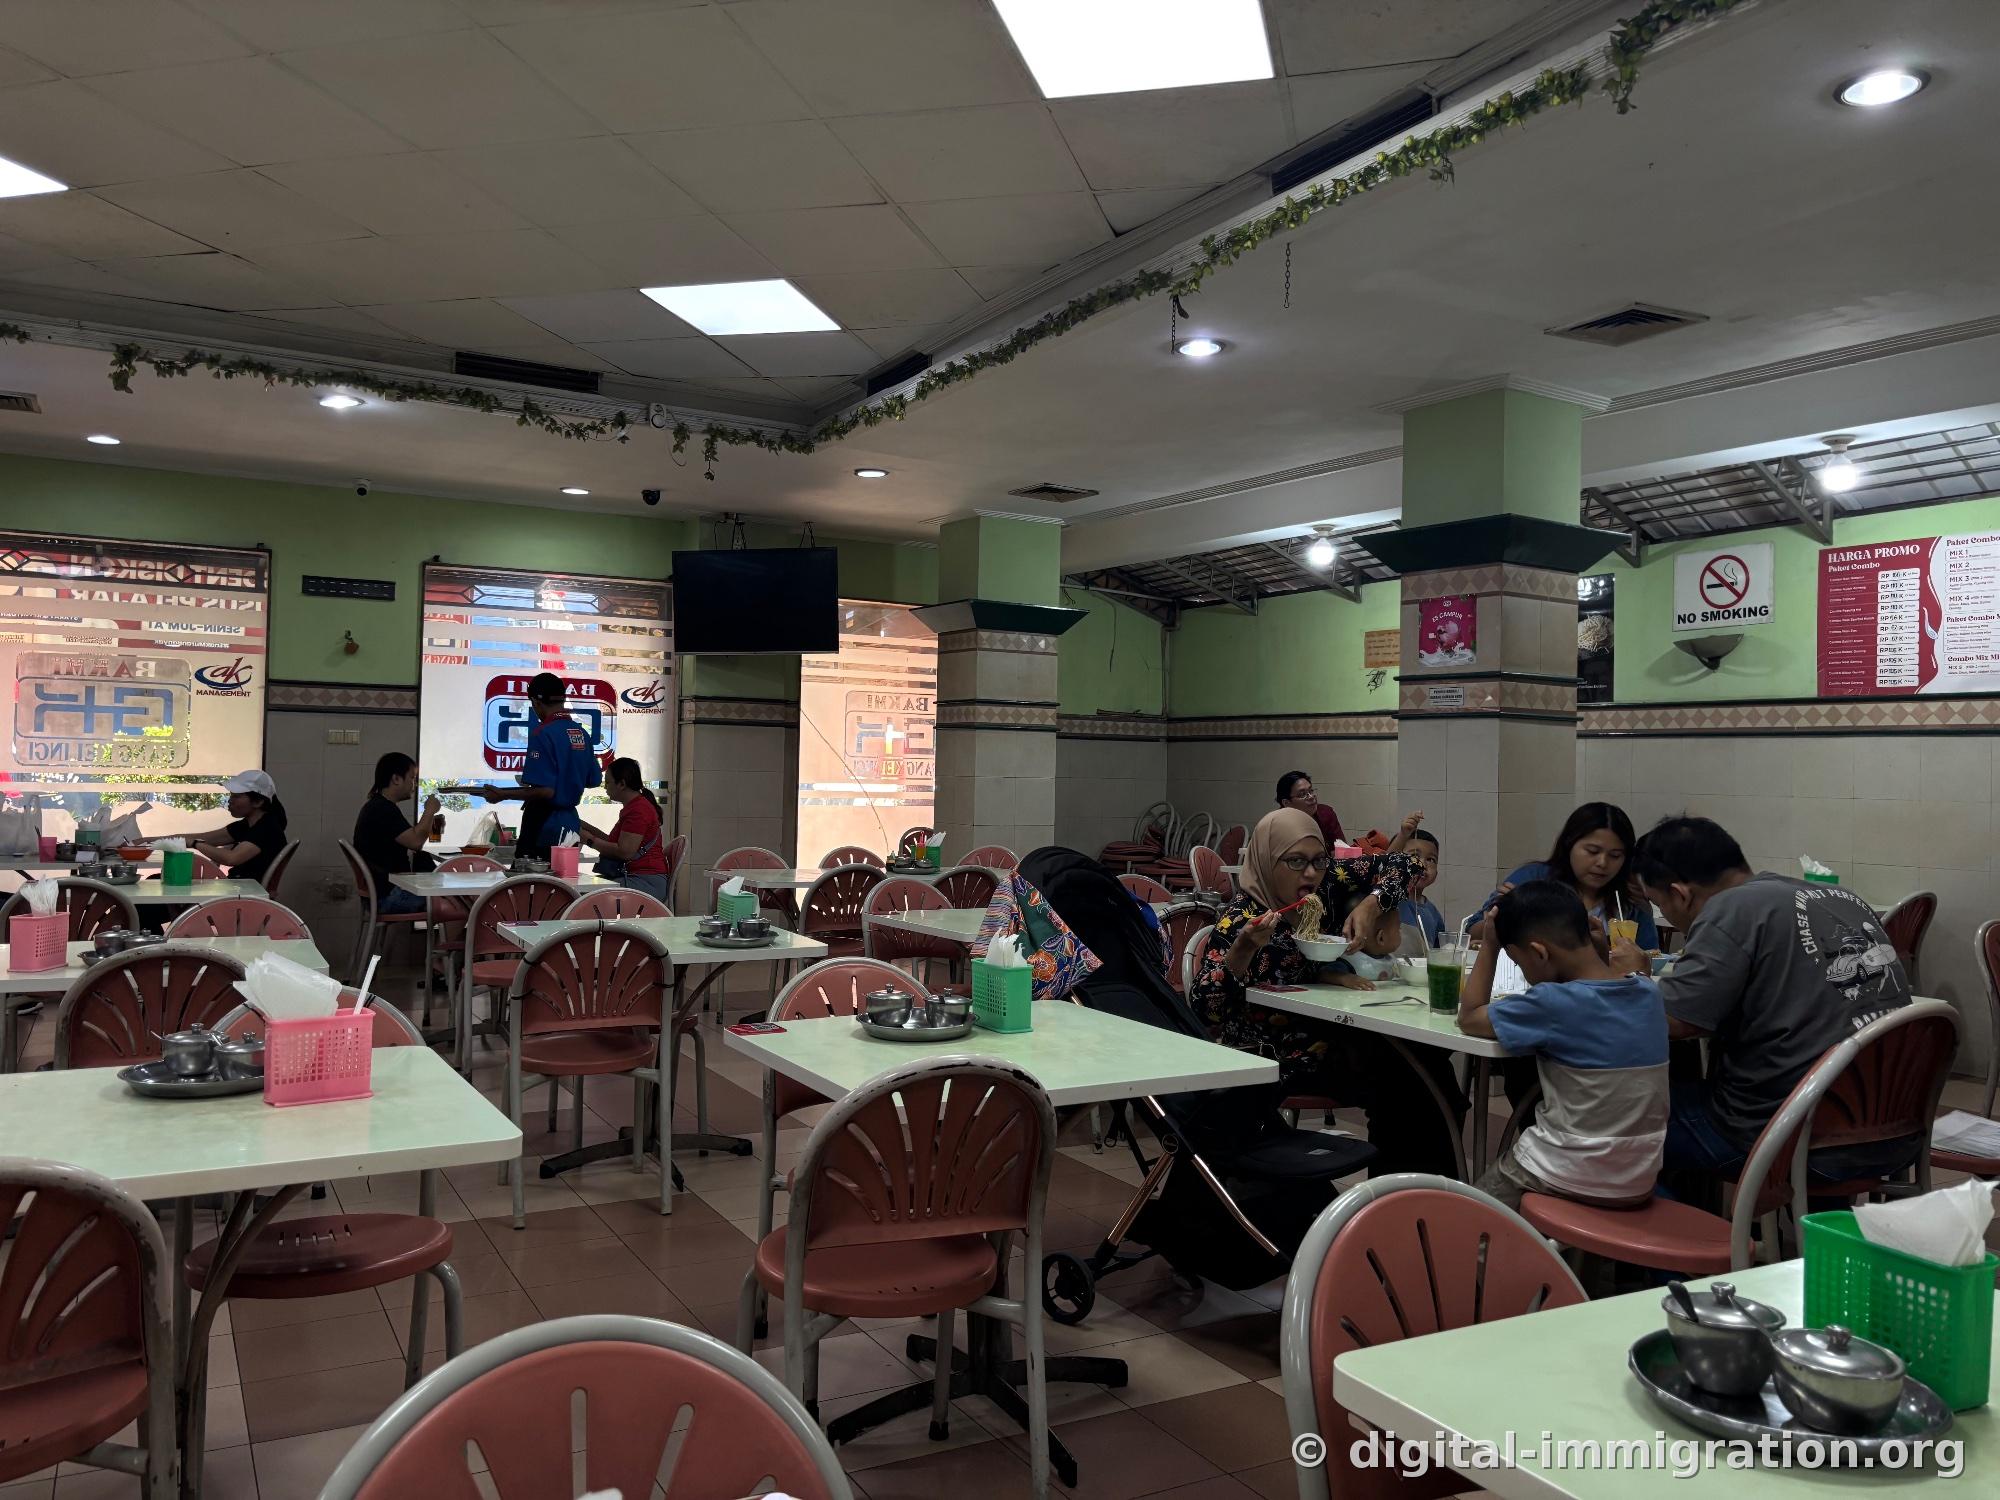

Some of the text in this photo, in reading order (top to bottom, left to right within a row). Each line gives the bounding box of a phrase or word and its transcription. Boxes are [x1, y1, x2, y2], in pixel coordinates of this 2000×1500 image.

[1828, 544, 1920, 564] HARGA PROMO
[1851, 562, 1880, 570] Combo
[1949, 562, 1963, 570] MIX
[1677, 606, 1769, 624] NO SMOKING
[196, 689, 252, 697] MANAGEMENT
[1796, 912, 1818, 954] CHASE
